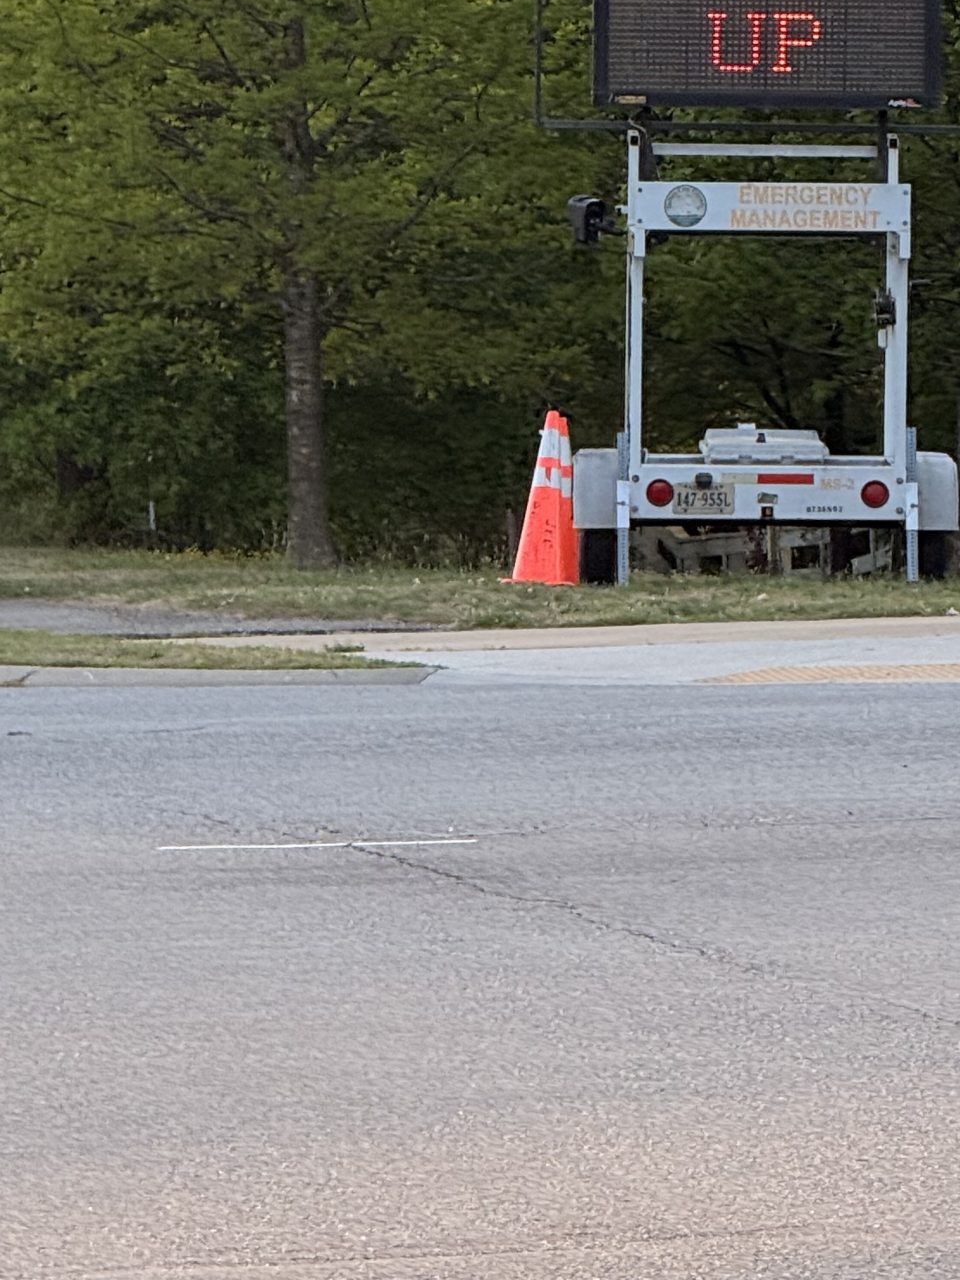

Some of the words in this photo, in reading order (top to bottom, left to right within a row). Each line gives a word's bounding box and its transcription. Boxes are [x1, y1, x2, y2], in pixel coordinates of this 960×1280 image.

[708, 13, 821, 72] UP
[738, 185, 872, 205] EMERGENCY
[730, 209, 881, 229] MANAGEMENT
[676, 491, 731, 507] 147-955L
